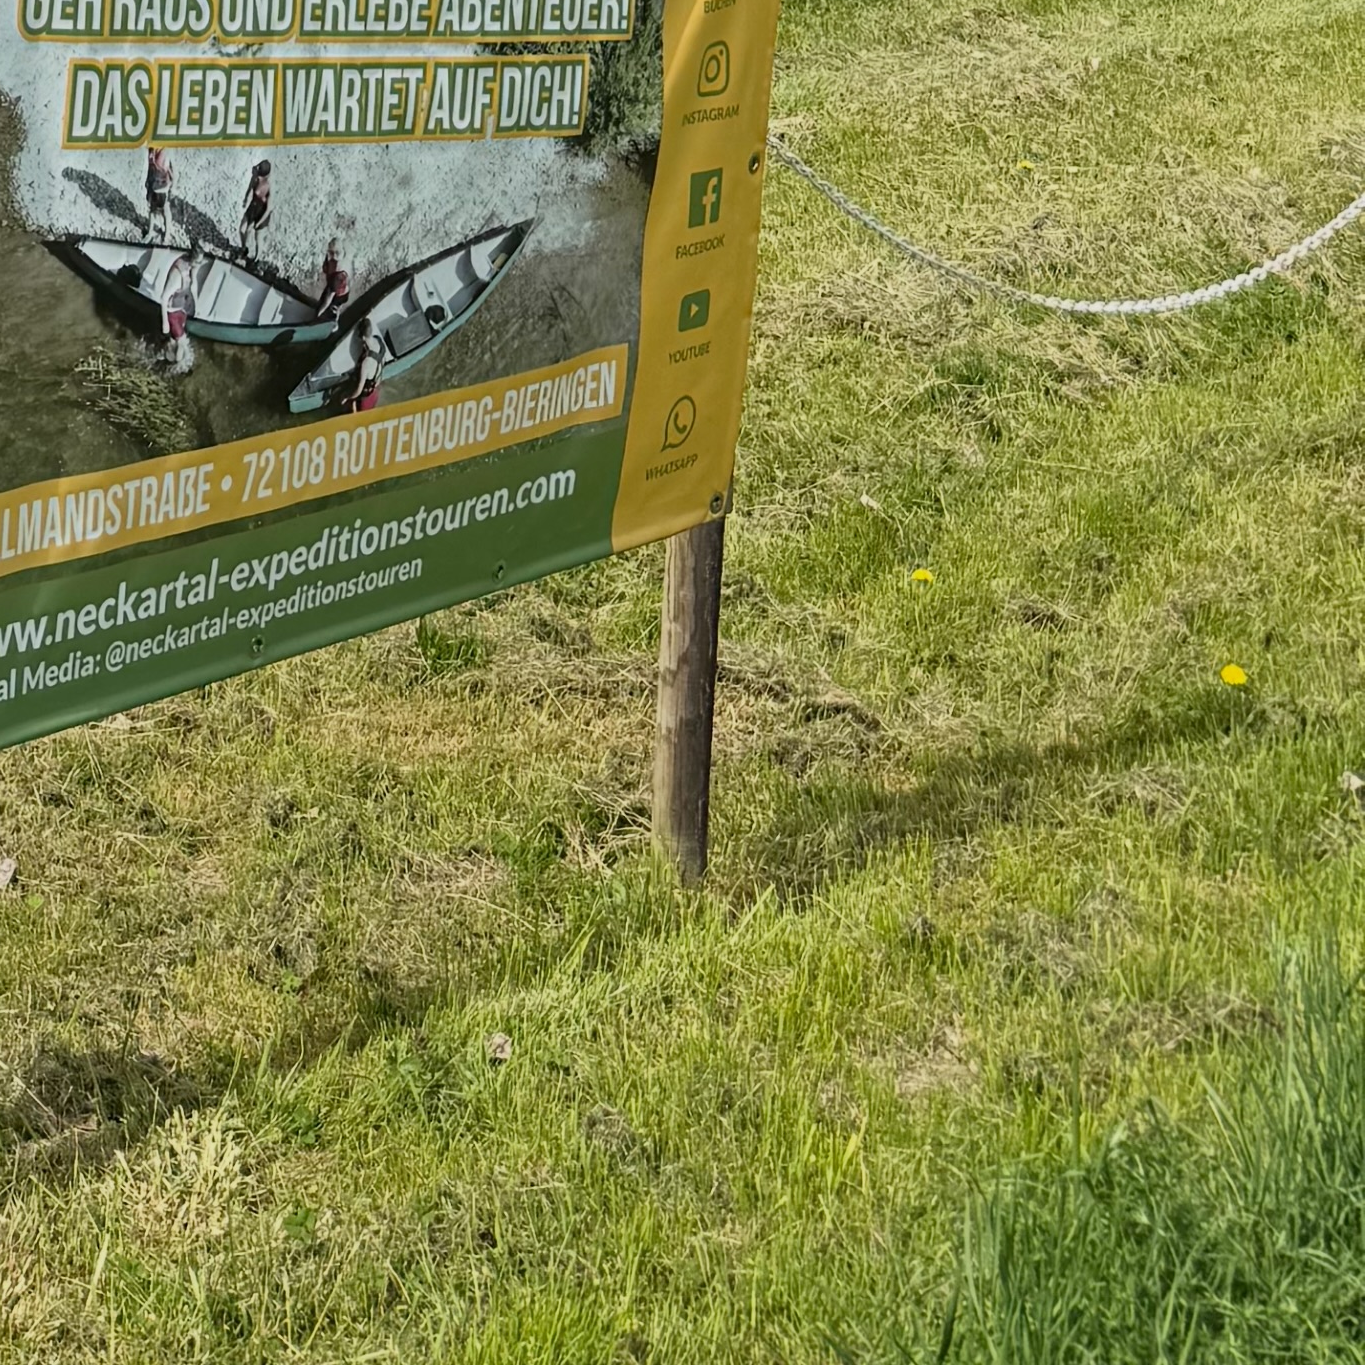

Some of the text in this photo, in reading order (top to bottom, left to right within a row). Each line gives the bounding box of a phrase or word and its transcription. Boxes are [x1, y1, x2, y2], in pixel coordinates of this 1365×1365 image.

[72, 65, 582, 137] DAS LEBEN WARTET AUF DICH!
[681, 104, 740, 126] INSTAGRAM
[676, 233, 726, 260] FACEBOOK
[668, 340, 712, 365] YOUTUBE
[241, 436, 326, 503] 72108
[332, 360, 617, 479] ROTTENBURG-BIERINGEN
[645, 453, 699, 482] WHATSAPP
[22, 653, 101, 695] Media:
[105, 558, 422, 671] @neckartal-expeditionstouren
